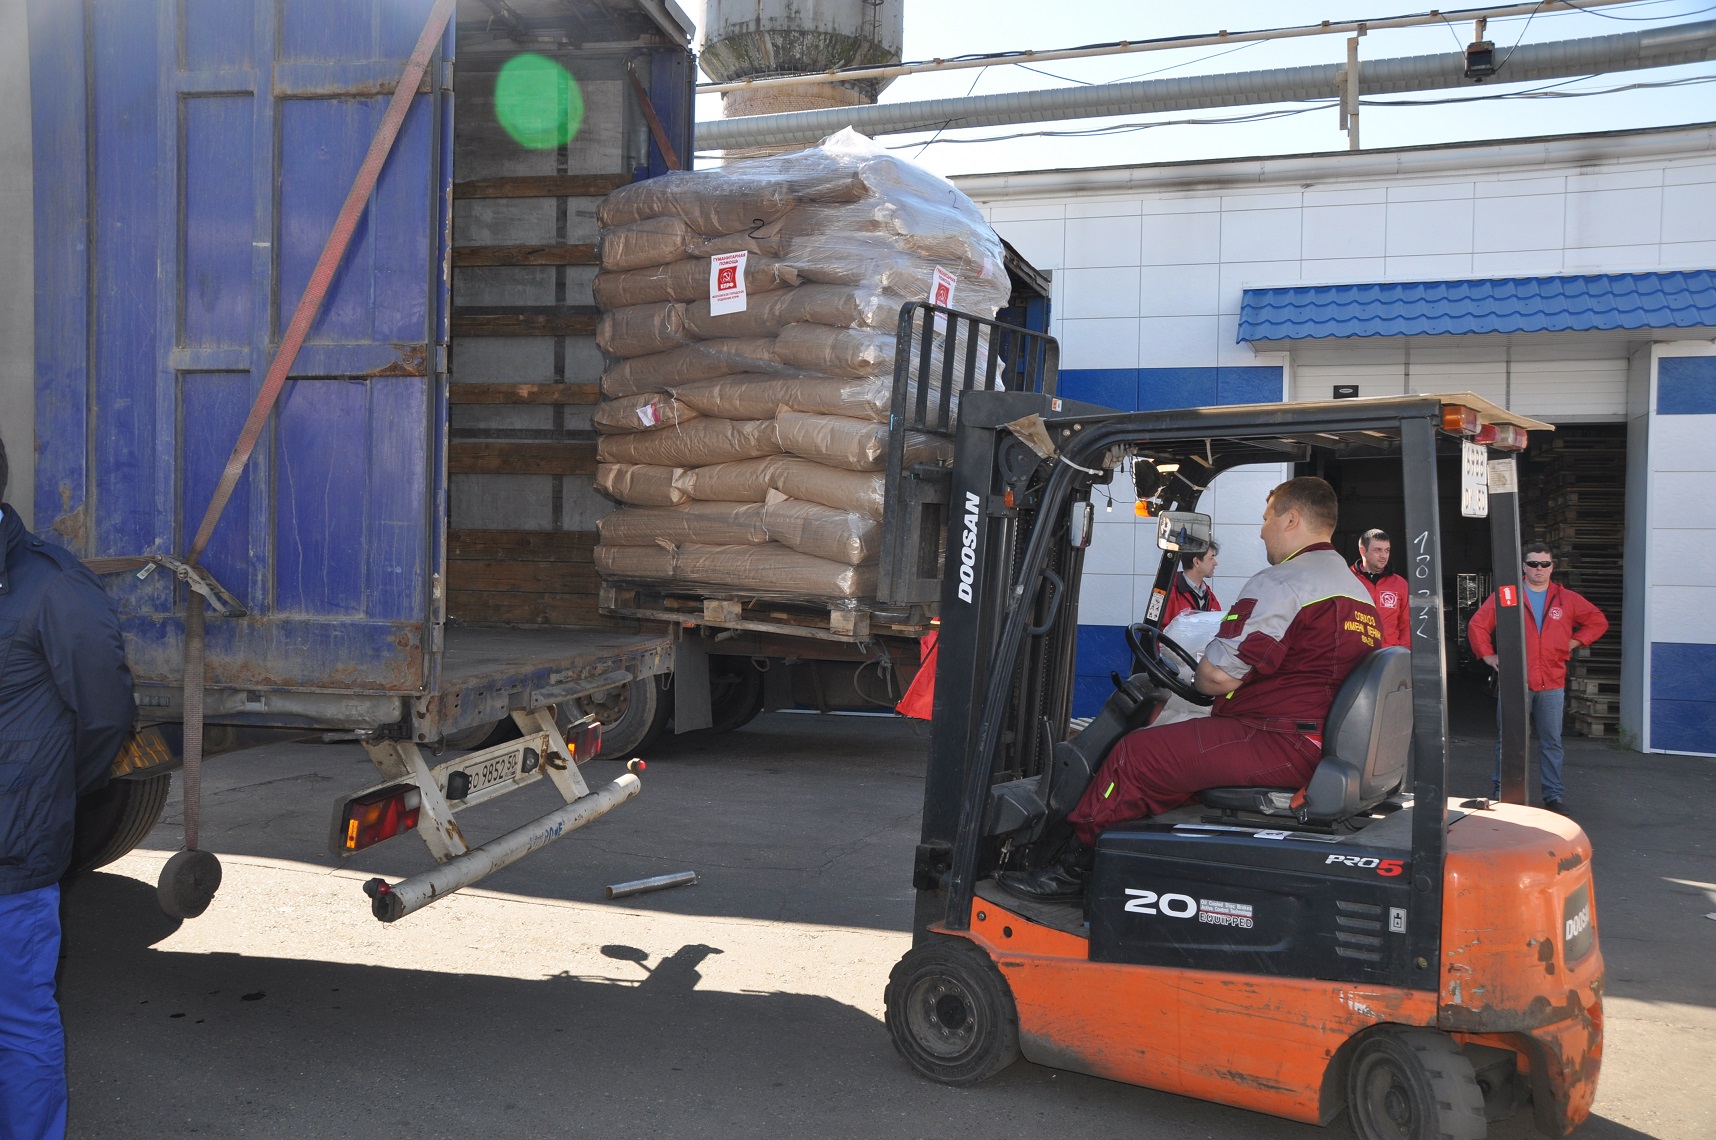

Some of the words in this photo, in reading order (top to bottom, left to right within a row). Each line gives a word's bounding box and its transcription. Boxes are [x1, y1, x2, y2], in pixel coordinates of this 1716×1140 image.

[957, 490, 981, 604] DOOSAN
[482, 759, 506, 786] 9852
[1325, 854, 1405, 876] PRO5
[1124, 888, 1198, 919] 20
[1199, 911, 1254, 929] EQUIPPED
